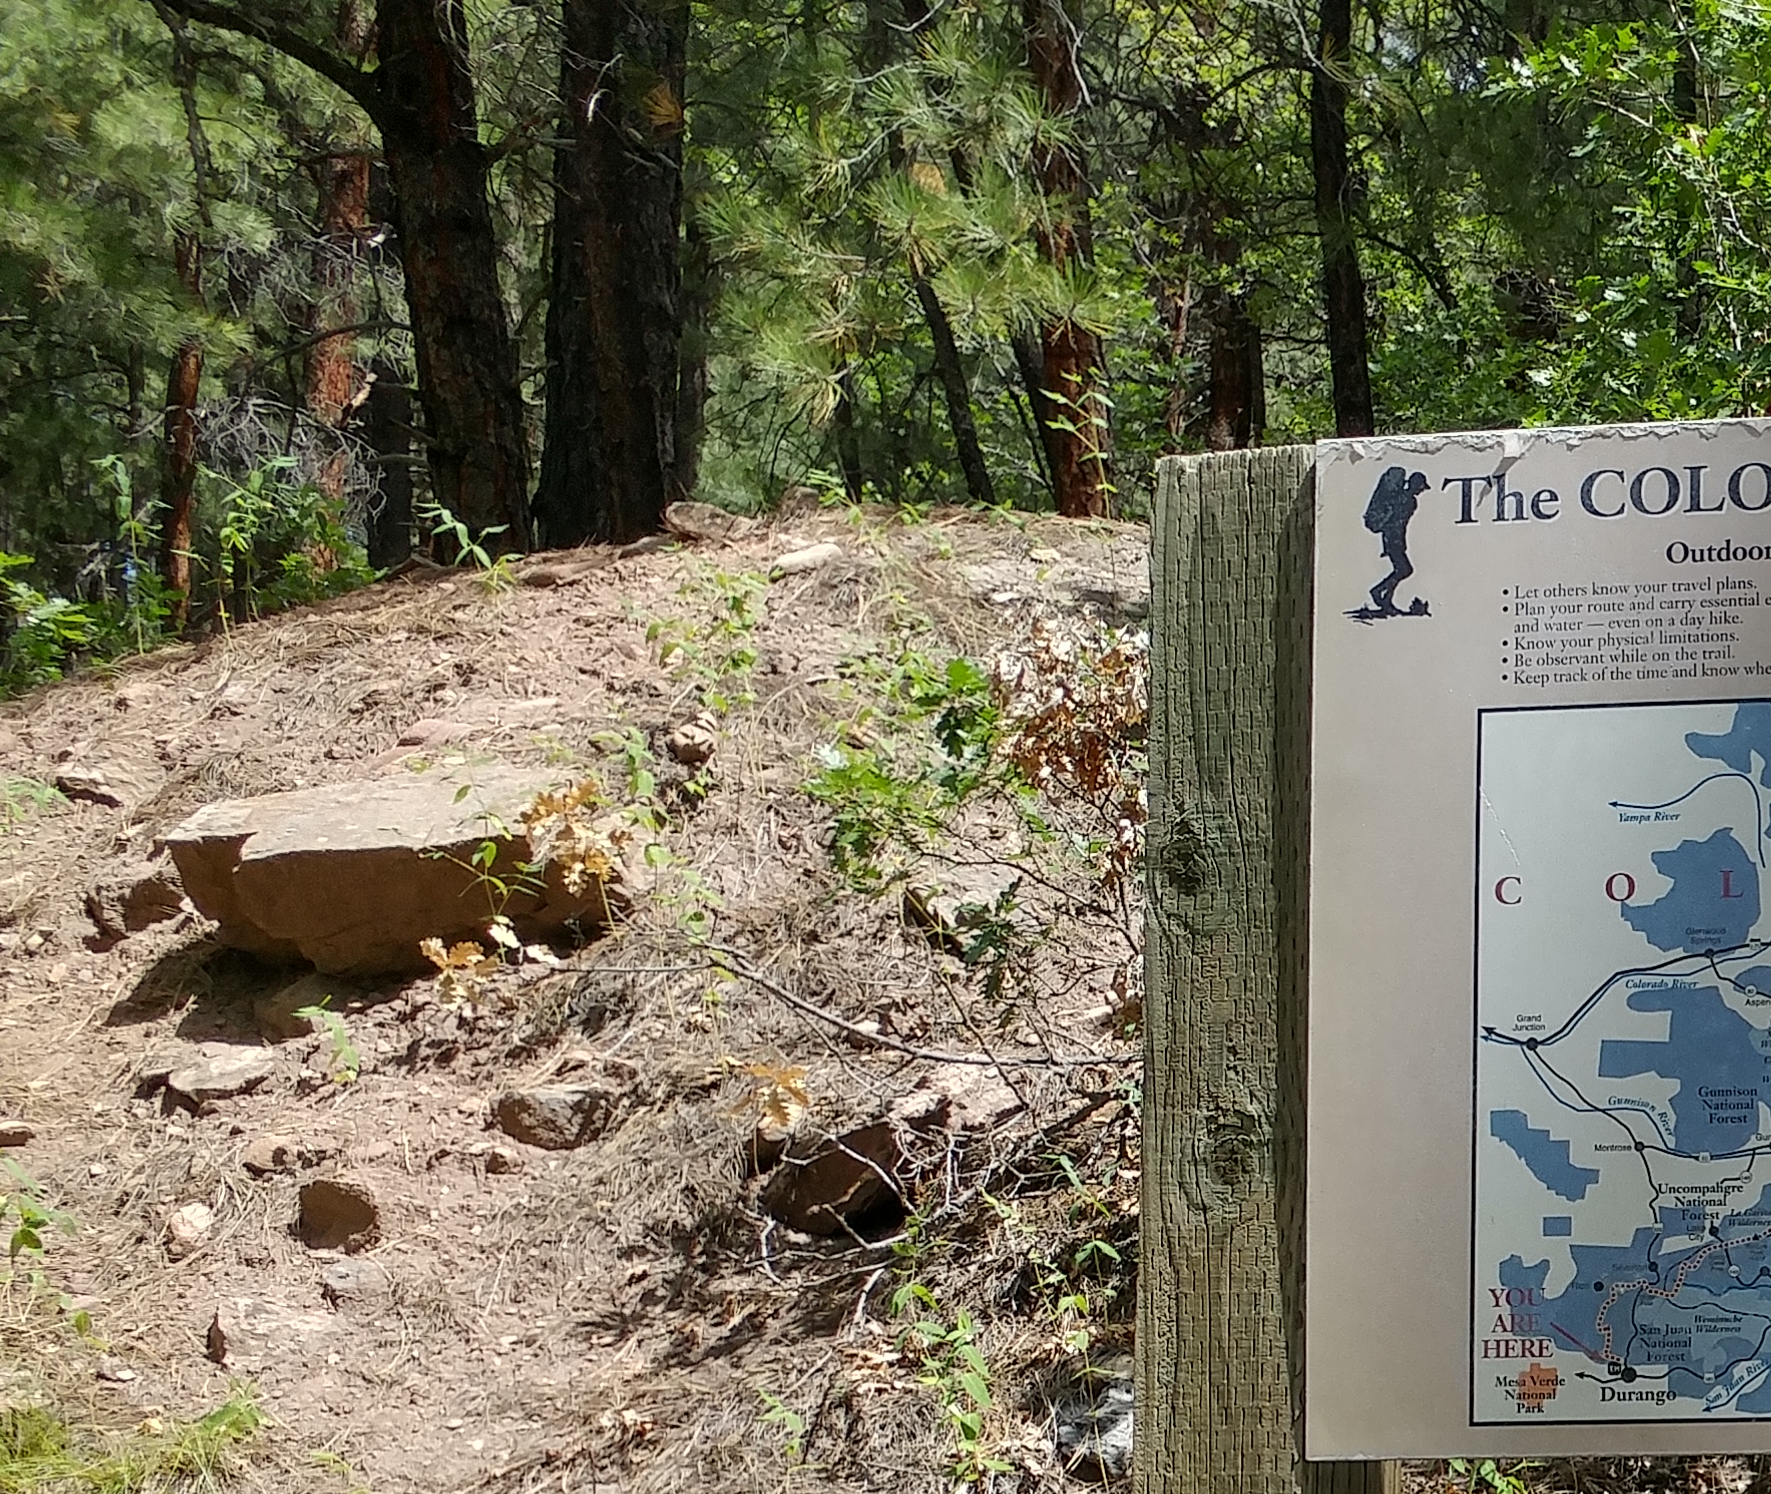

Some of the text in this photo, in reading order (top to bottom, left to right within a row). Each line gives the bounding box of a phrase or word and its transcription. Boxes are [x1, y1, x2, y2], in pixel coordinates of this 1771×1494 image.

[1441, 472, 1560, 524] The
[1515, 578, 1757, 599] Let others know your travel plans.
[1617, 811, 1680, 823] Yampa River
[1517, 1014, 1542, 1024] Grand
[1512, 1022, 1545, 1032] Junction
[1698, 1085, 1758, 1098] Gunnison
[1702, 1099, 1754, 1111] National
[1709, 1112, 1748, 1124] Forest
[1595, 1144, 1632, 1152] Montrose
[1489, 1288, 1546, 1309] YOU
[1490, 1313, 1542, 1333] ARE
[1481, 1339, 1554, 1358] HERE
[1495, 1375, 1565, 1387] Mesa Verde
[1505, 1389, 1556, 1400] National
[1601, 1387, 1676, 1406] Durango
[1517, 1402, 1544, 1413] Park
